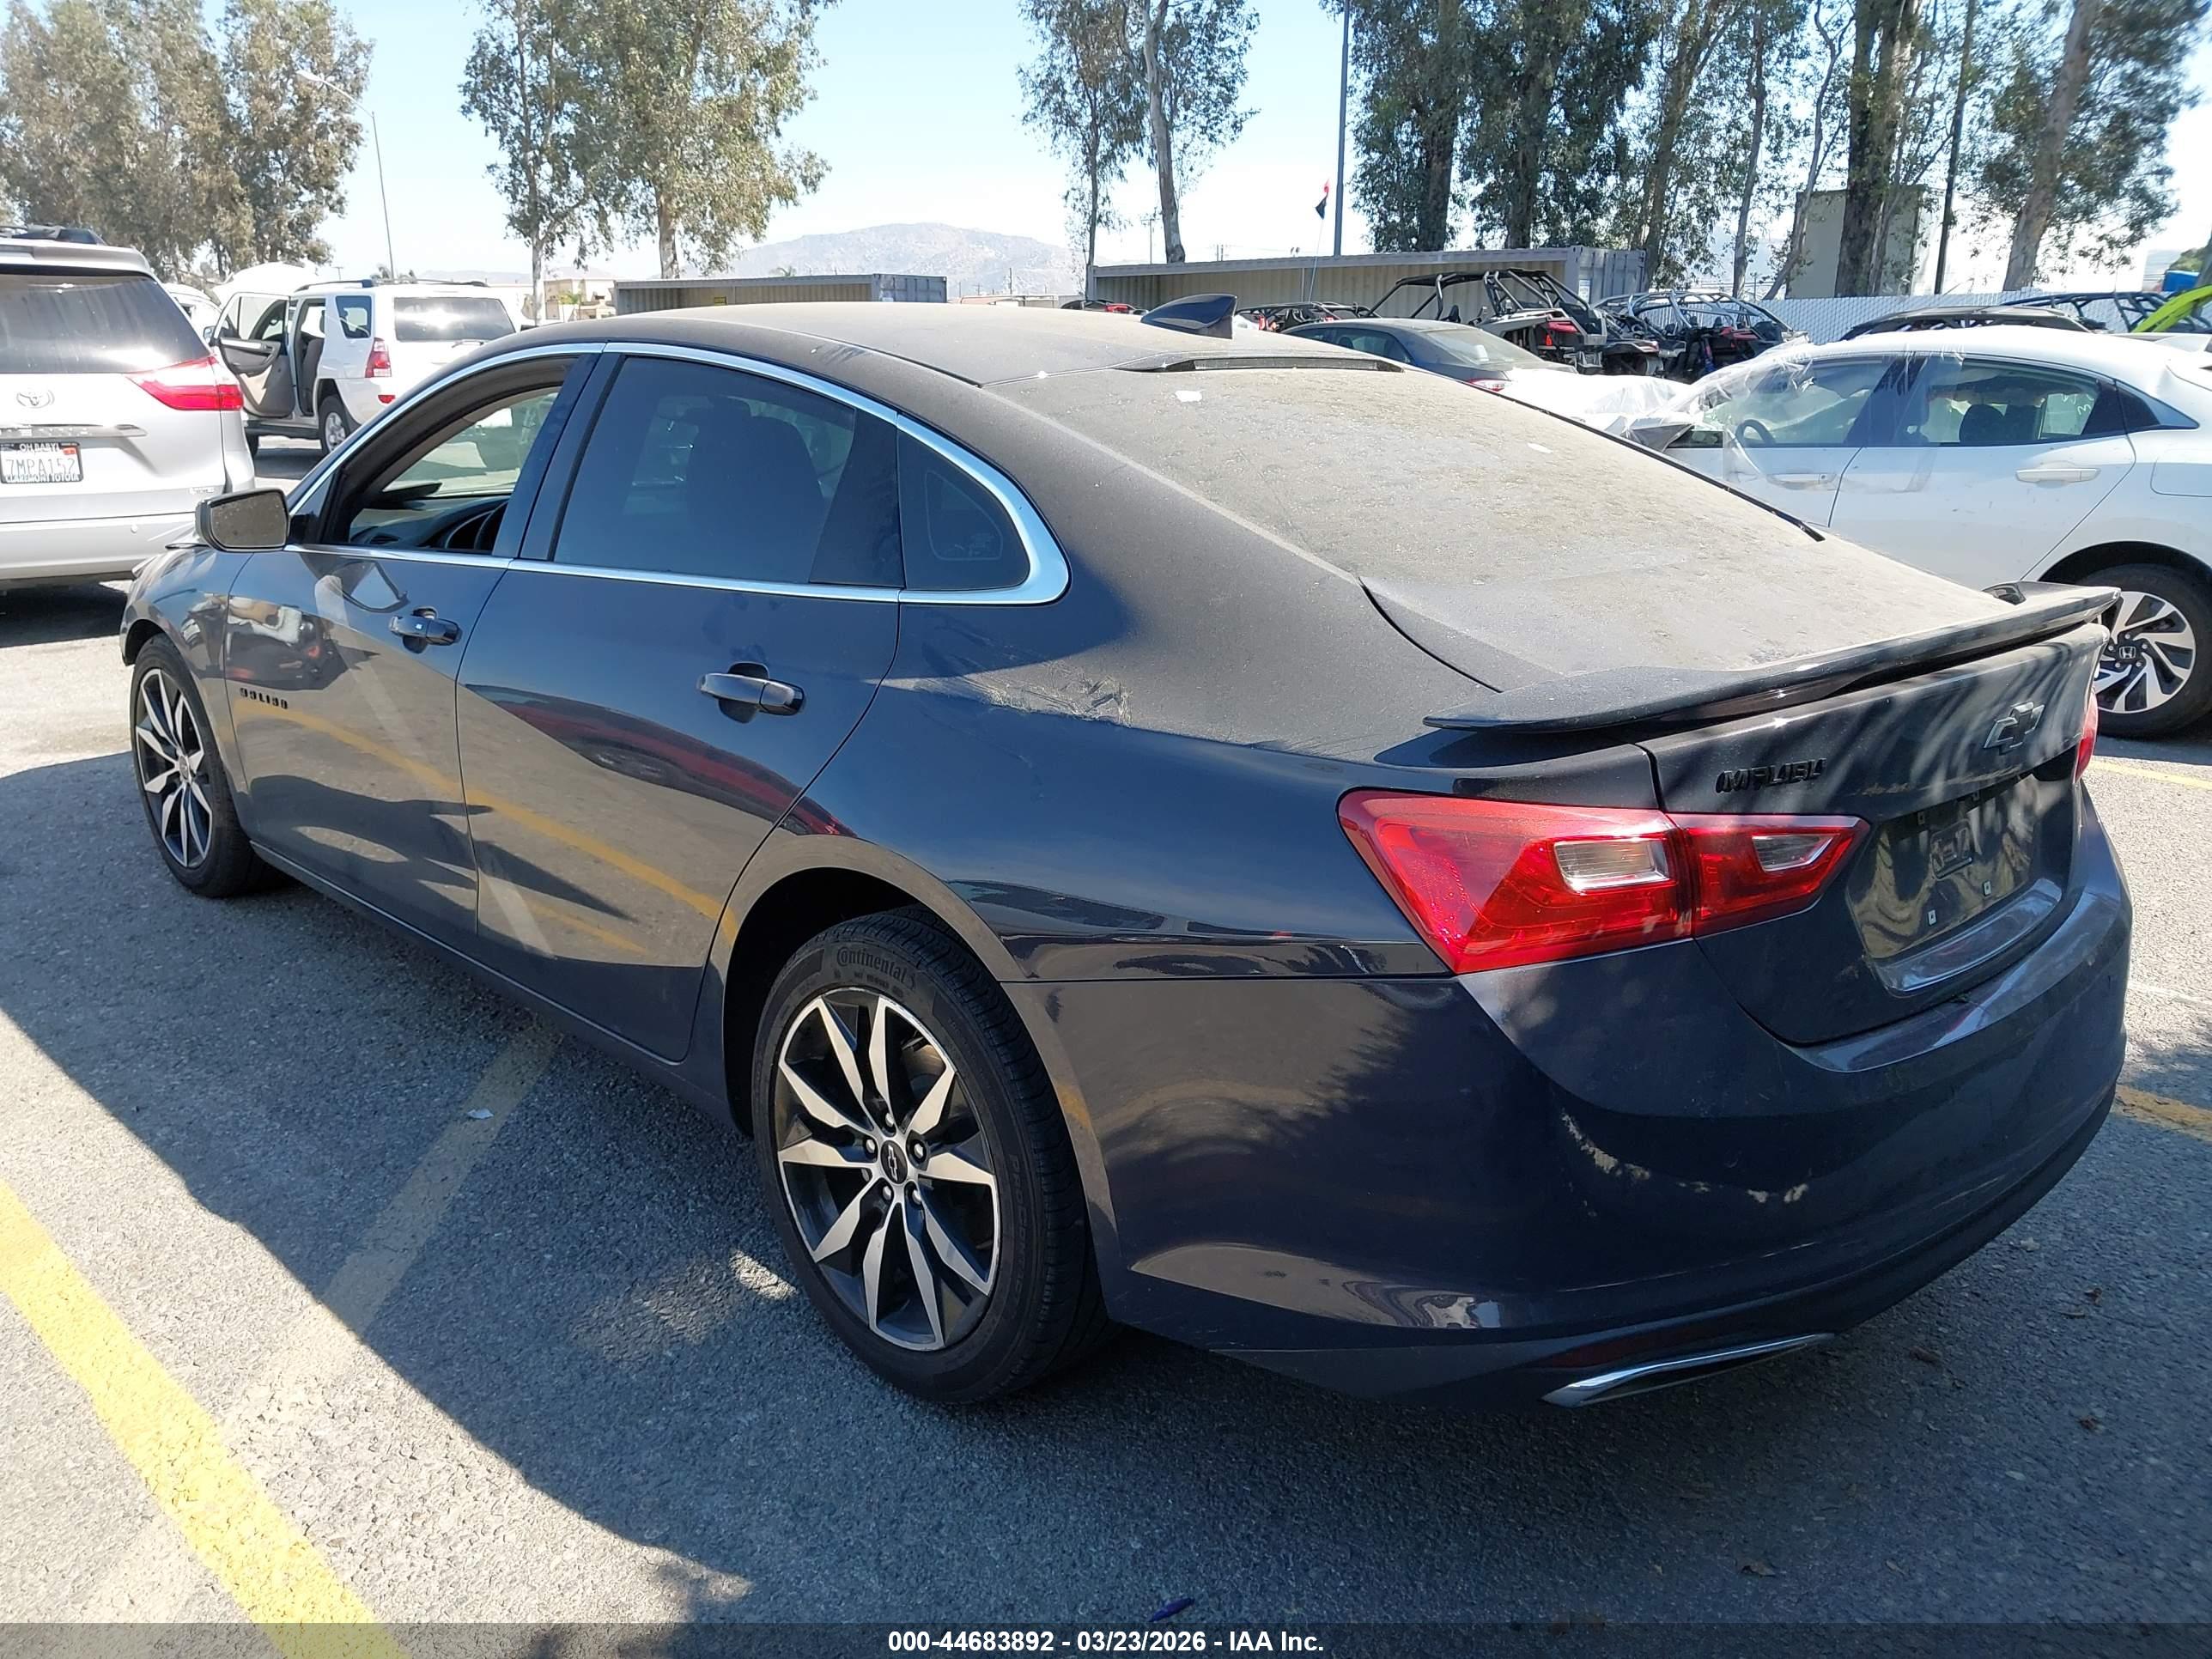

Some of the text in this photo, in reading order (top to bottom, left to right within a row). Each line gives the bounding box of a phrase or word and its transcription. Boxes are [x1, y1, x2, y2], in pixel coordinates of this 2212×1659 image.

[20, 442, 33, 453] OH
[6, 458, 76, 475] 7MPA152
[836, 946, 908, 985] Continental
